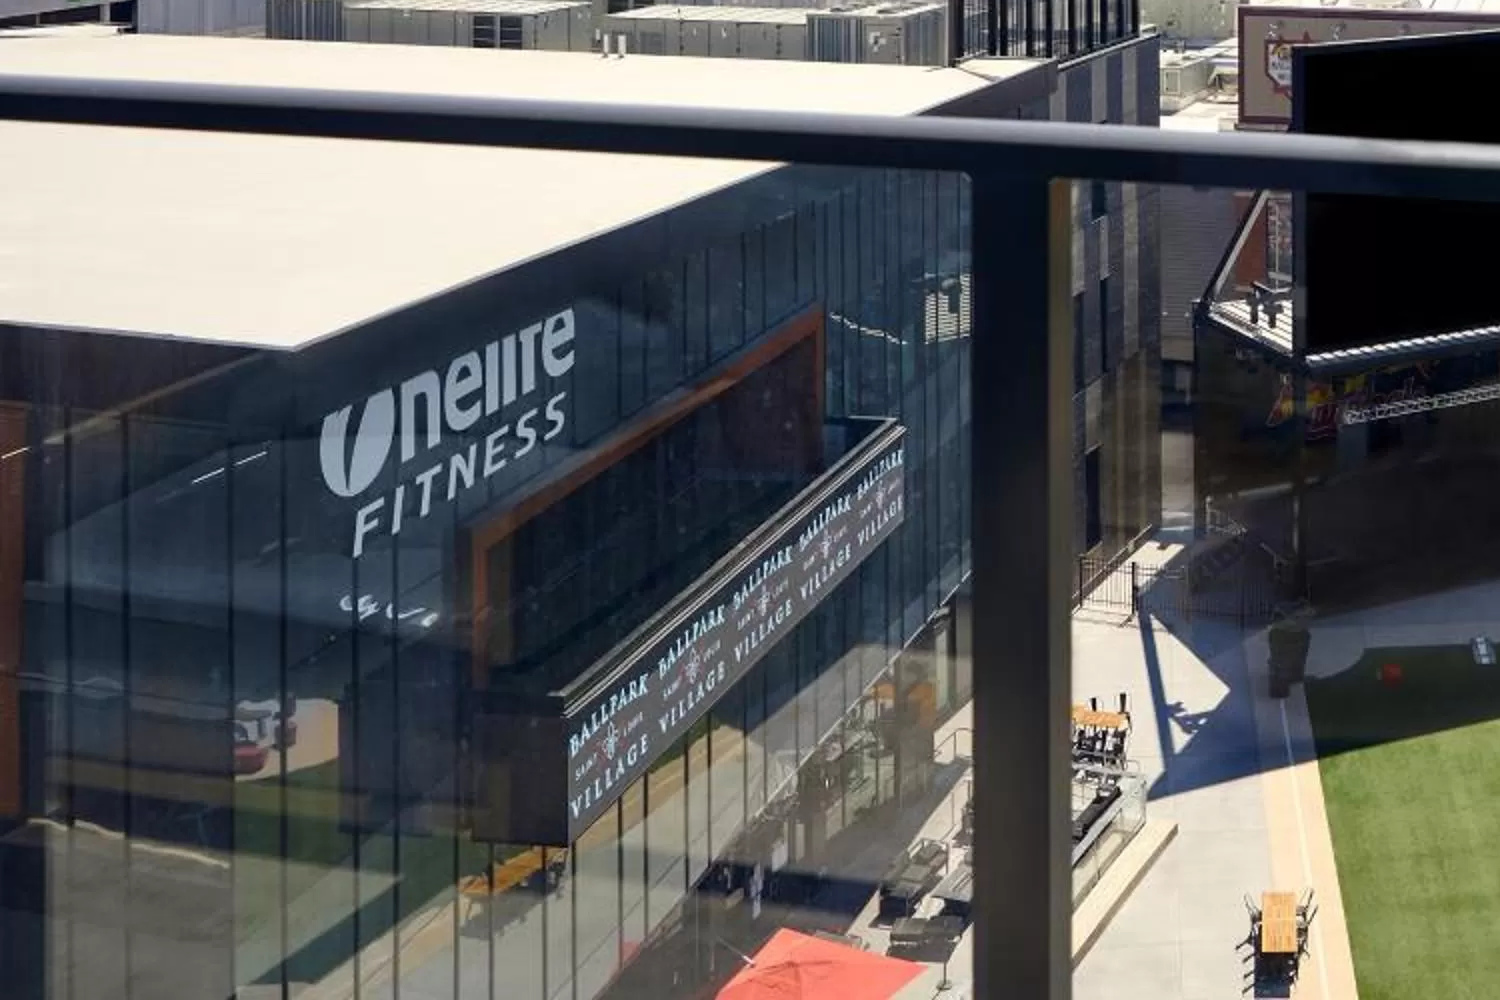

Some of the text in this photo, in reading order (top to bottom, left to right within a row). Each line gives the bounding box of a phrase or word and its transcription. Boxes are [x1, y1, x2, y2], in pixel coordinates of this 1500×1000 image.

[353, 391, 567, 559] FITNESS
[733, 545, 792, 611] BALLPARK
[658, 604, 725, 681] BALLPARK
[734, 599, 792, 663] VILLAGE
[569, 673, 649, 758] BALLPARK
[658, 660, 726, 734] VILLAGE
[570, 733, 649, 819] VILLAGE
